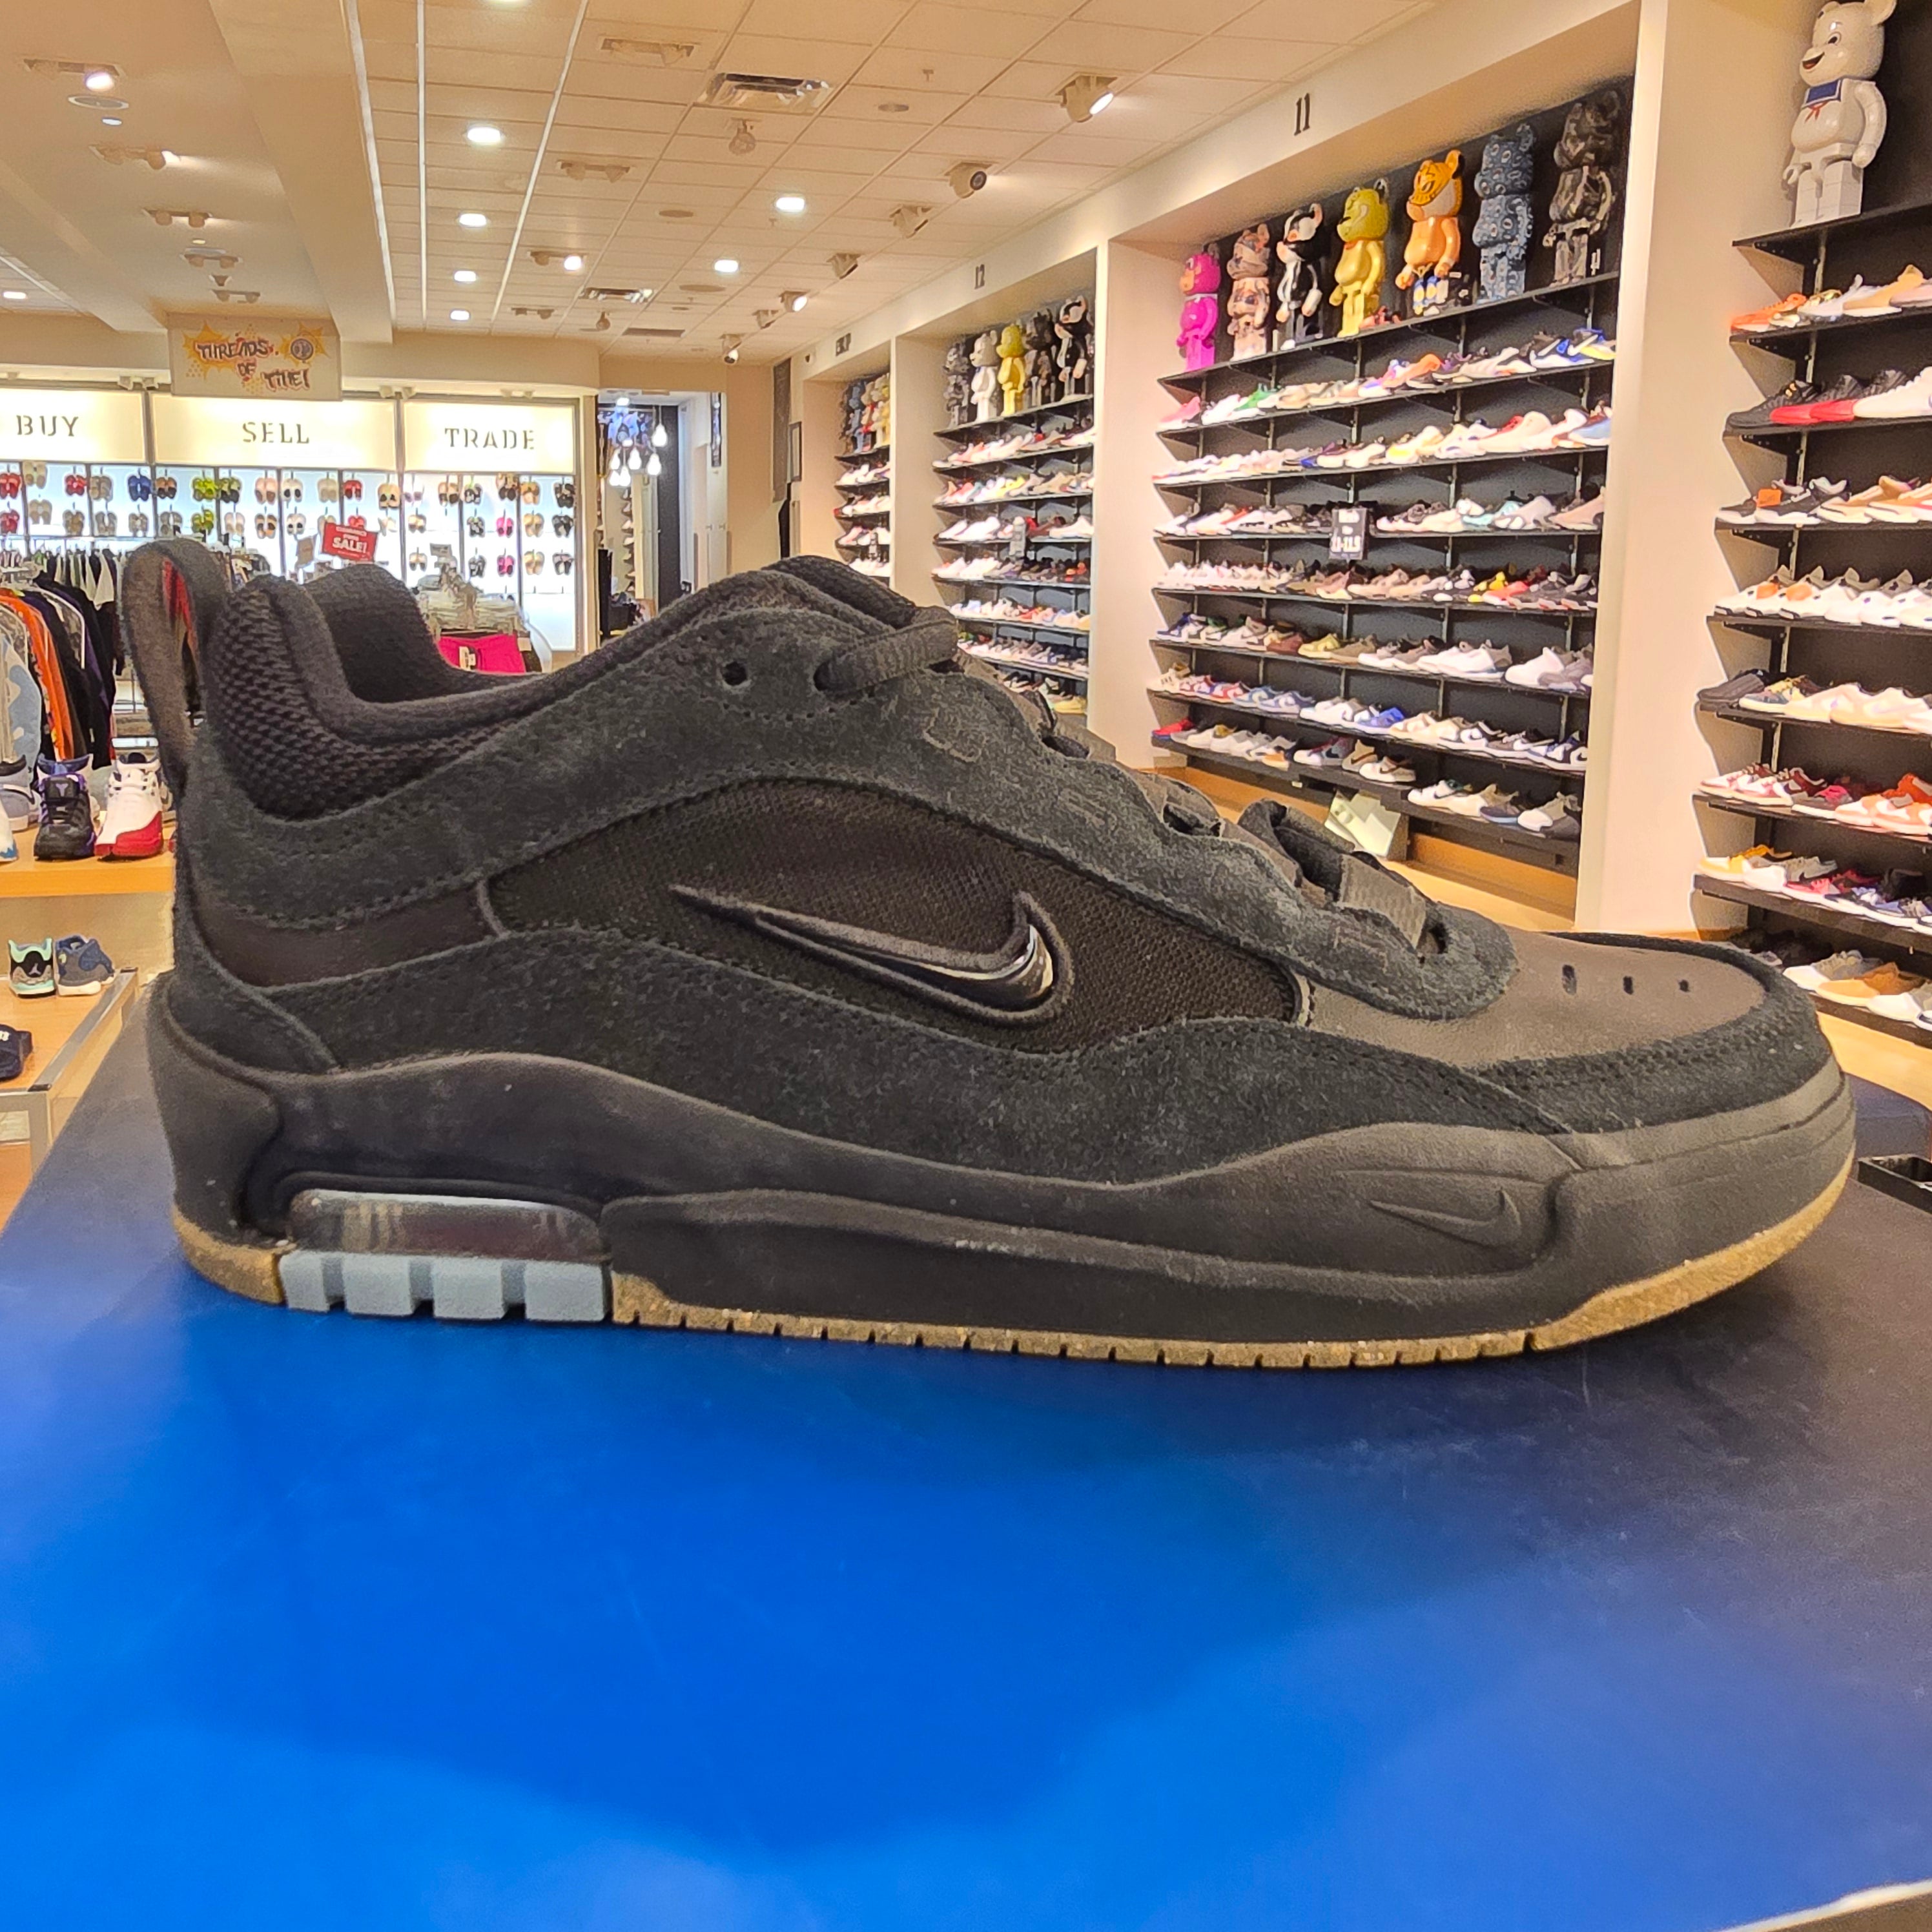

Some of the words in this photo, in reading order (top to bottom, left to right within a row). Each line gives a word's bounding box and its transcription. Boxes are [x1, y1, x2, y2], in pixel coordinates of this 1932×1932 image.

[1293, 93, 1310, 136] 11
[16, 415, 79, 437] BUY
[242, 422, 309, 444] SELL
[444, 427, 534, 449] TRADE
